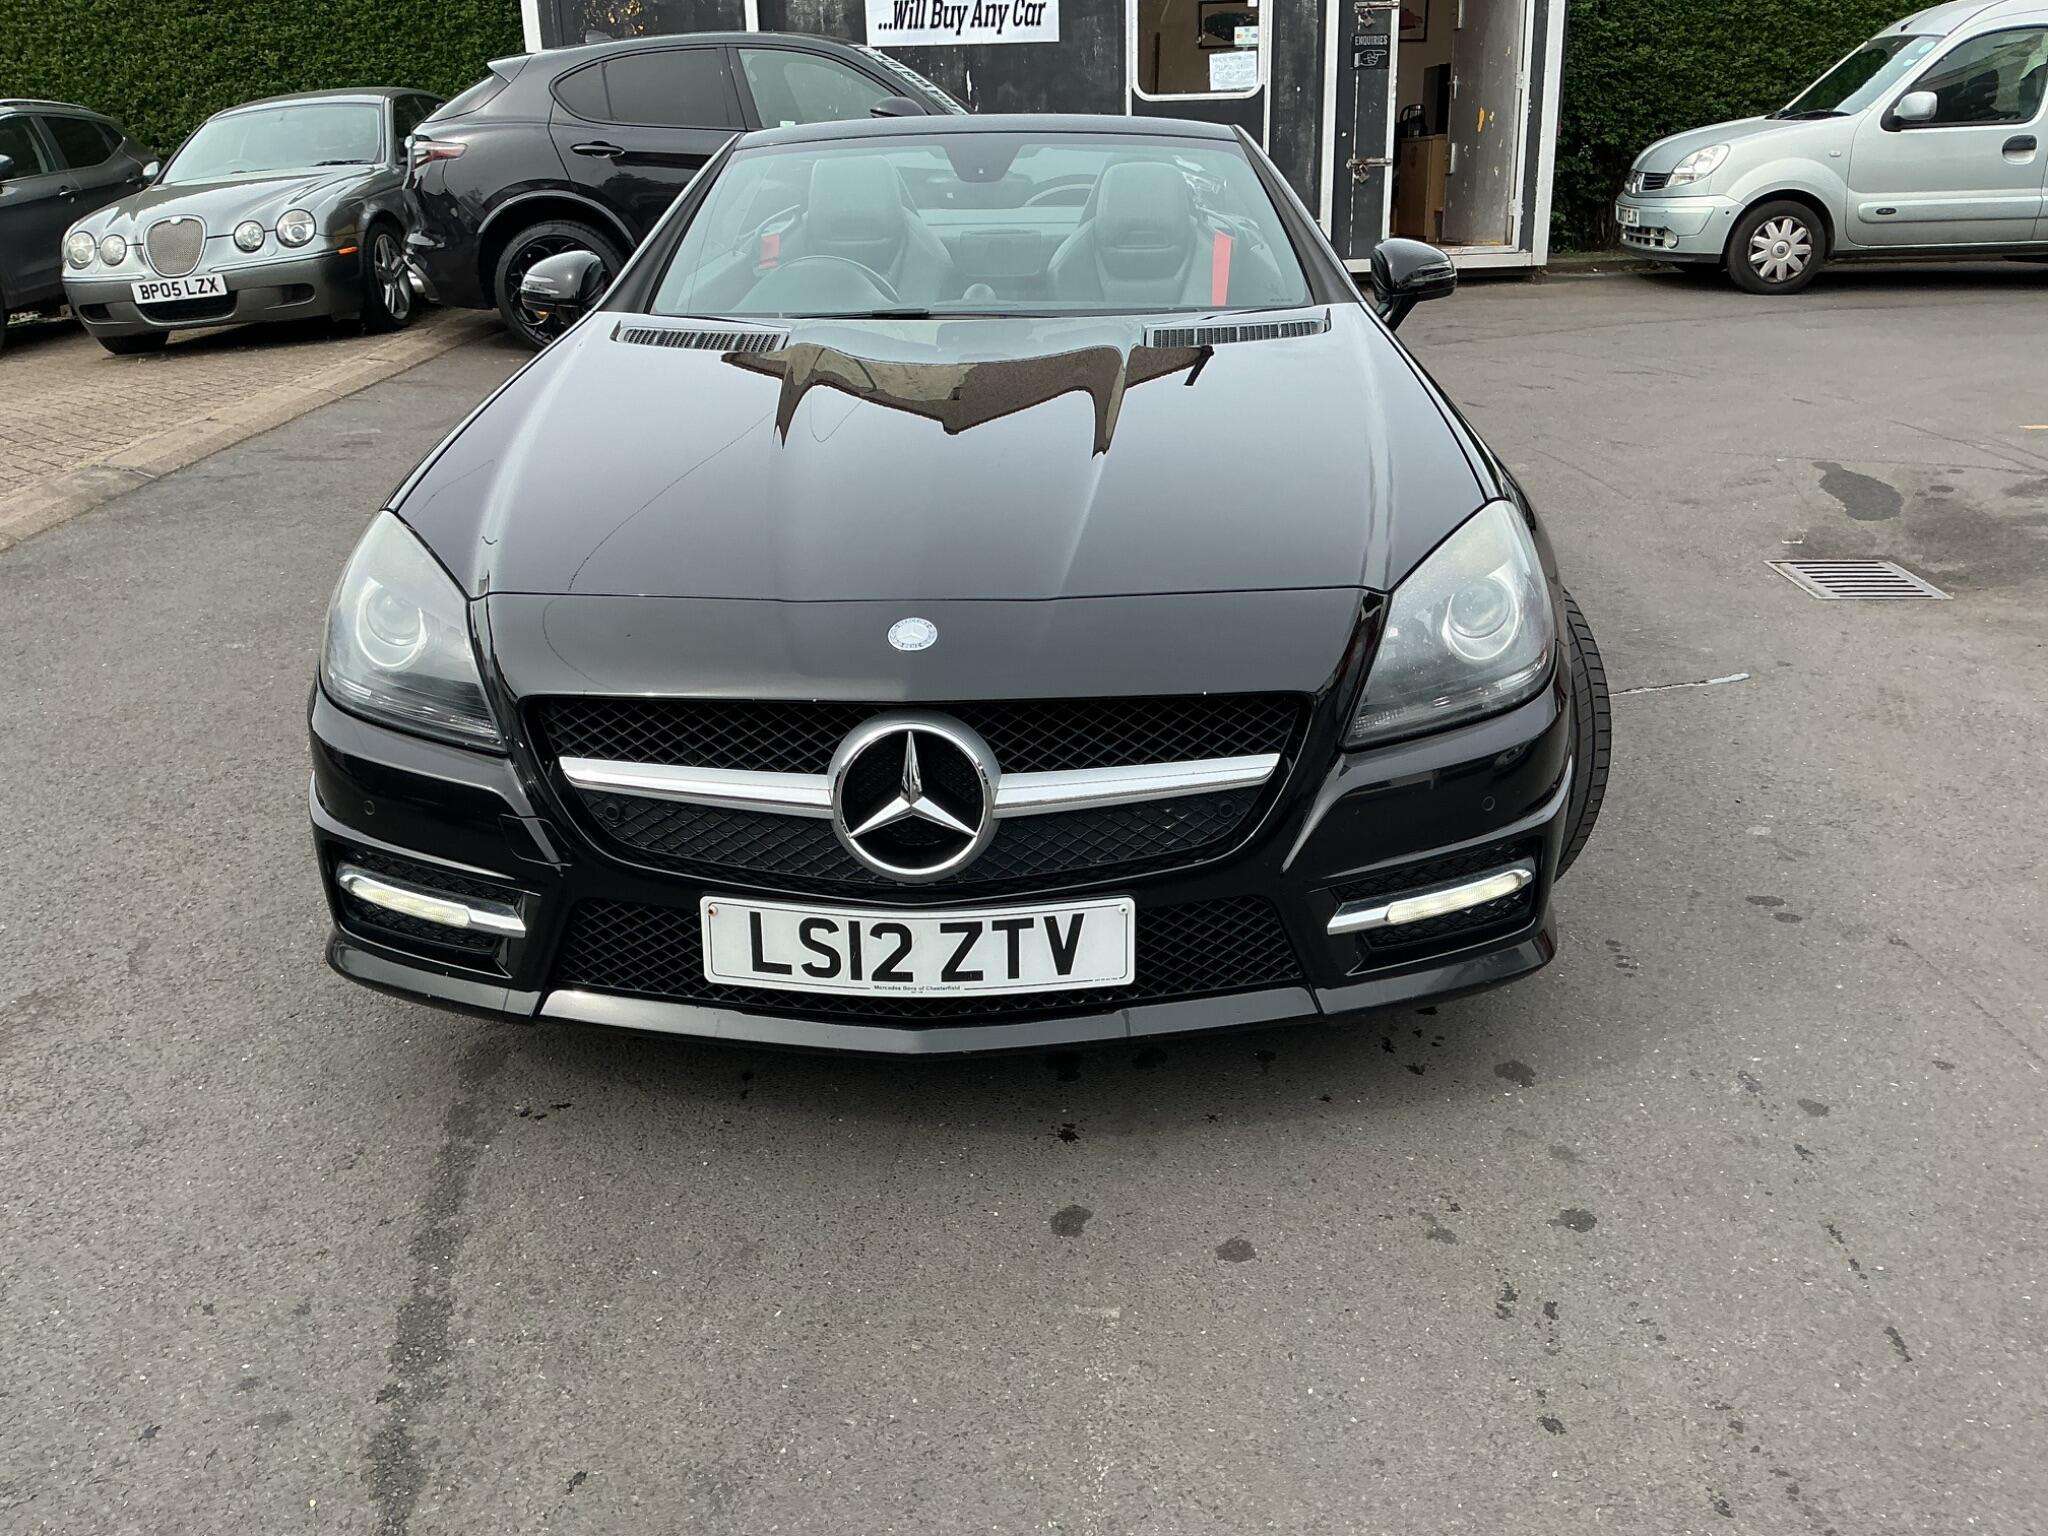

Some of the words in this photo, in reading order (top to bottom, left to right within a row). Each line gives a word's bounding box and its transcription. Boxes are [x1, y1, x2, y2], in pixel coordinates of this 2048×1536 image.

[930, 0, 968, 36] Buy
[970, 2, 1009, 35] Any
[1013, 0, 1046, 27] Car
[1354, 34, 1388, 46] ENQUIRIES
[139, 281, 182, 300] BP05
[185, 277, 219, 296] LZX
[749, 911, 914, 983] LS12
[939, 912, 1085, 983] ZTV
